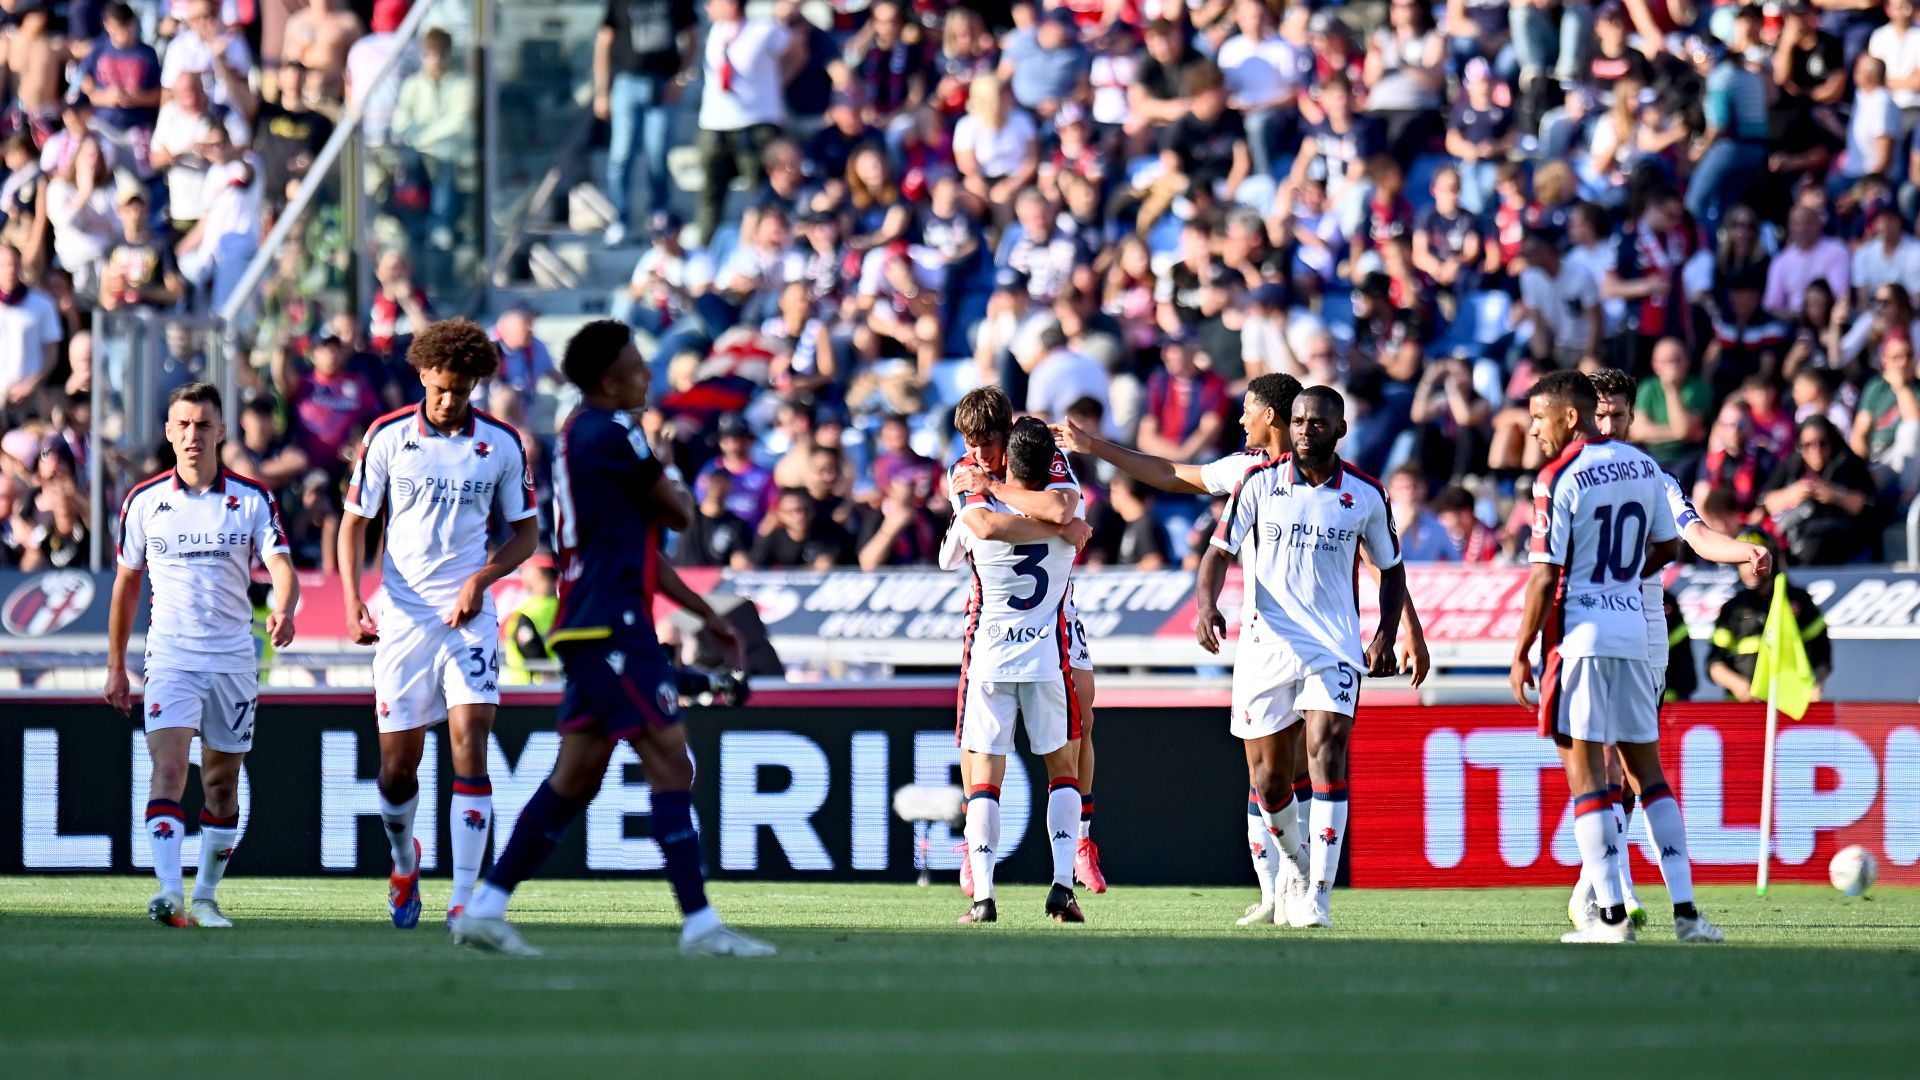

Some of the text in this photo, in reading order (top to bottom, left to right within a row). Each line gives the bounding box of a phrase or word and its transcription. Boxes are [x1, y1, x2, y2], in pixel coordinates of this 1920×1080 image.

[1573, 460, 1656, 490] MESSIAS JR
[425, 477, 493, 493] PULSEE
[178, 533, 247, 546] PULSEE
[1291, 523, 1355, 541] PULSEE
[1322, 543, 1338, 552] Gas
[1590, 501, 1647, 584] 10
[213, 549, 231, 558] Gas
[1007, 543, 1049, 611] 3
[1600, 594, 1640, 611] MSC
[1004, 623, 1049, 643] MSC
[469, 647, 499, 680] 34
[1337, 661, 1353, 689] 5
